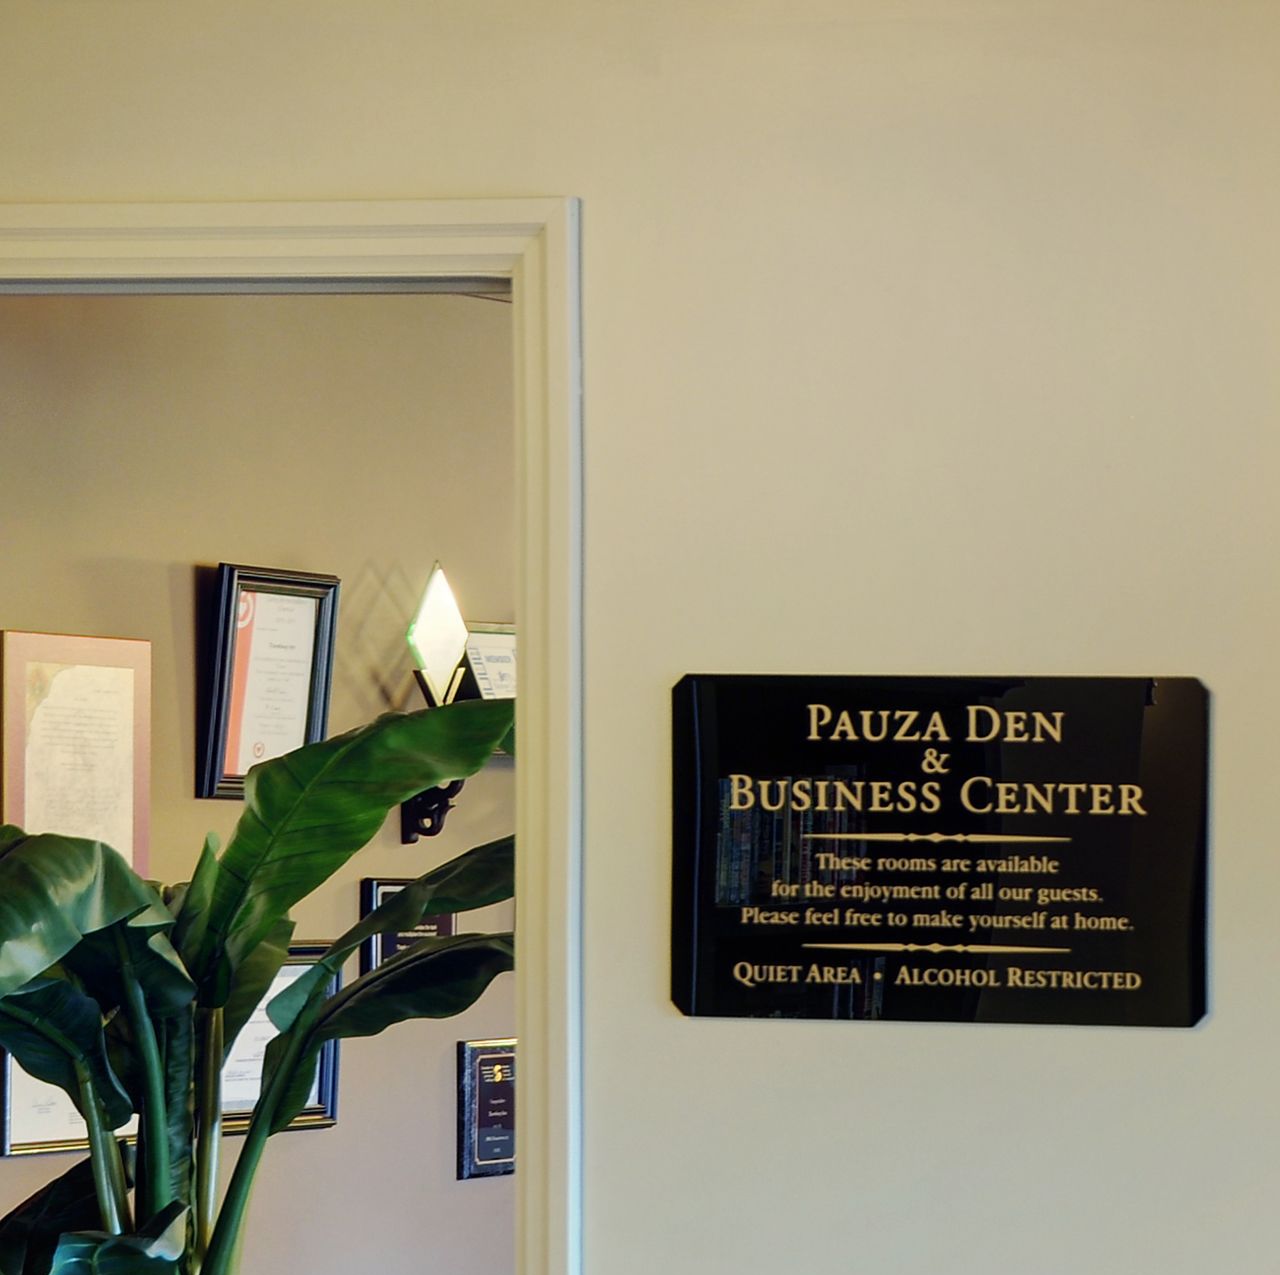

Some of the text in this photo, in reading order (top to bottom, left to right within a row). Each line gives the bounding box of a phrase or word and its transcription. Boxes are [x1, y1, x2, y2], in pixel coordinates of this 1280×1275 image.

[806, 704, 1065, 743] PAUZA DEN
[920, 748, 950, 774] &
[728, 774, 1148, 815] BUSINESS CENTER
[815, 853, 1059, 873] These rooms are available
[771, 880, 1103, 905] for the enjoyment of all our guests.
[741, 907, 1134, 932] Please feel free to make yourself at home.
[733, 961, 1142, 989] QUIET AREA ALCOHOL RESTRICTED
